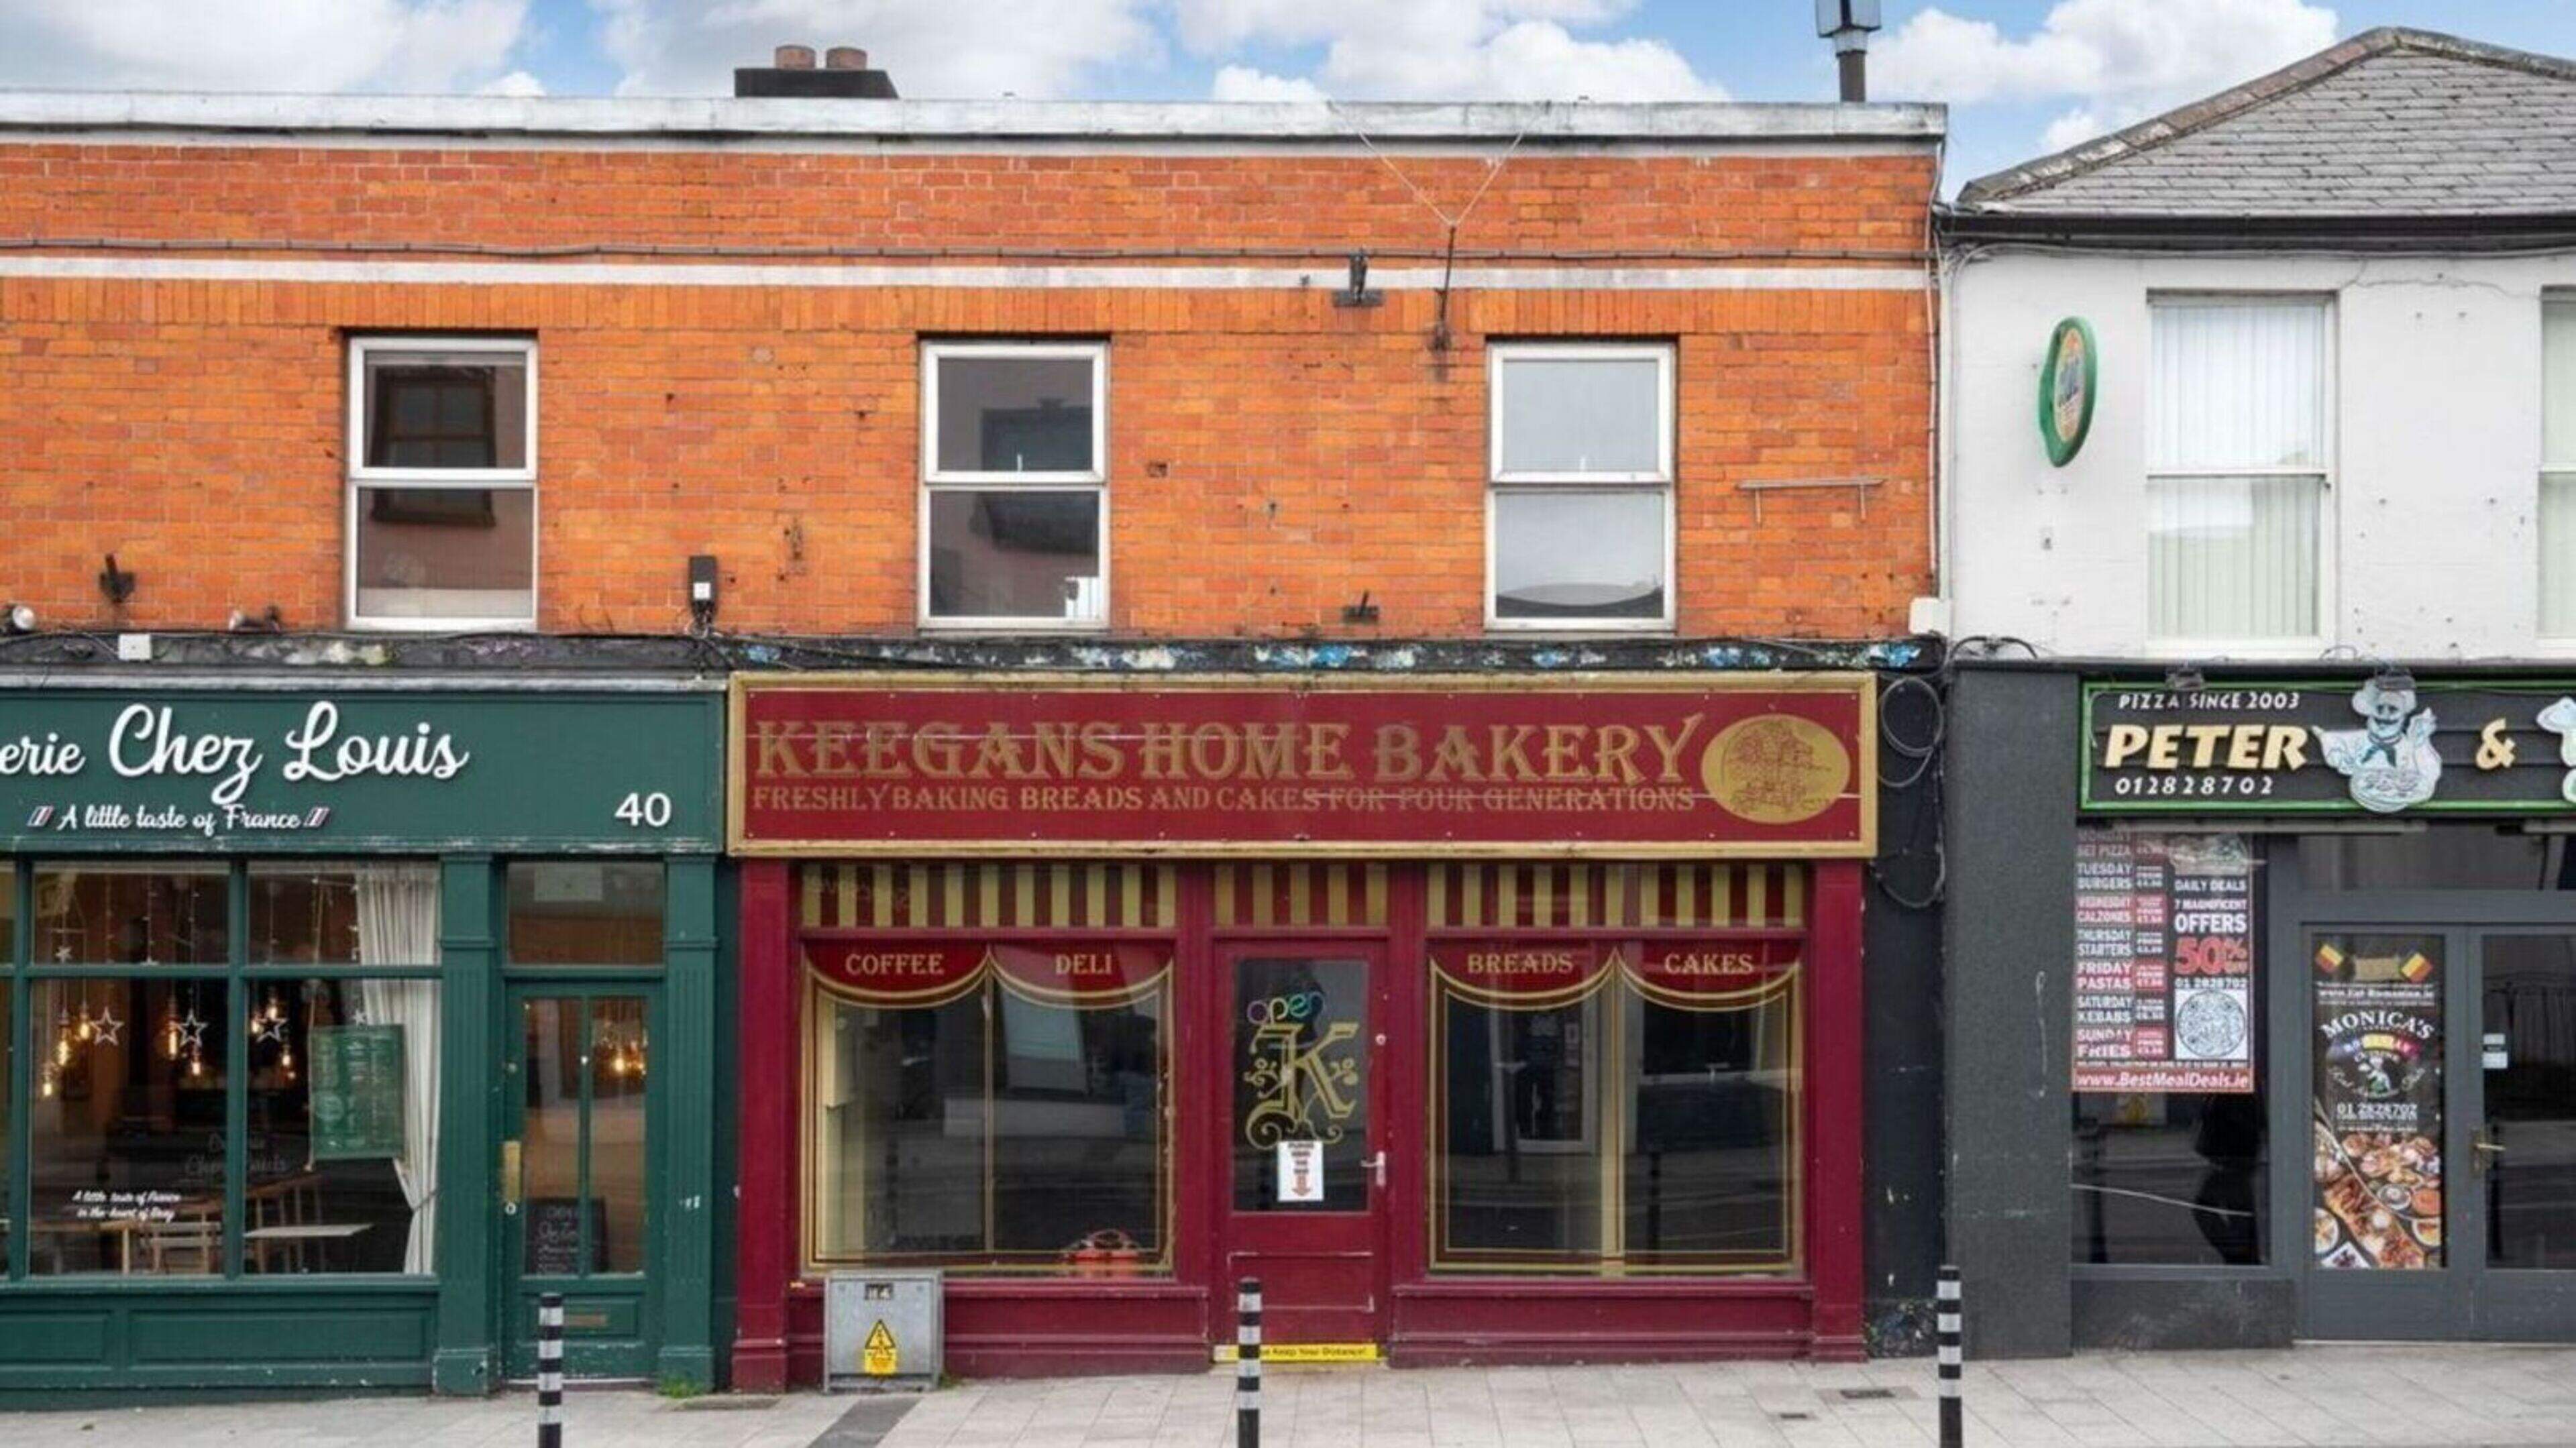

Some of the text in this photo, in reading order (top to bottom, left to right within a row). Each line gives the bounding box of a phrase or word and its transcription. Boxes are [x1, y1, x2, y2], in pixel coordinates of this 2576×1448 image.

[2118, 691, 2301, 710] PIZZA SINCE 2003
[0, 701, 470, 805] erie Chez Louis
[755, 712, 1705, 785] KEEGANS HOME BAKERY
[2104, 718, 2516, 771] PETER &
[753, 784, 1695, 813] FRESHLY BAKING BREADS AND CAKES FOR FOUR GENERATIONS
[57, 804, 301, 837] A little taste of France
[614, 792, 672, 828] 40
[2077, 862, 2131, 875] TUESDAY
[2174, 879, 2247, 891] DAILY DEALS
[2174, 913, 2247, 934] OFFERS
[845, 954, 945, 975] COFFEE
[1055, 954, 1113, 975] DELI
[1466, 952, 1574, 974] BREADS
[1664, 952, 1754, 975] CAKES
[2078, 962, 2132, 975] FRIDAY
[2078, 977, 2131, 990] PASTAS
[2077, 1028, 2132, 1042] SUNDAY
[2320, 1010, 2435, 1040] MONICA'S
[2077, 1071, 2249, 1088] www.BestMealDeals.ie
